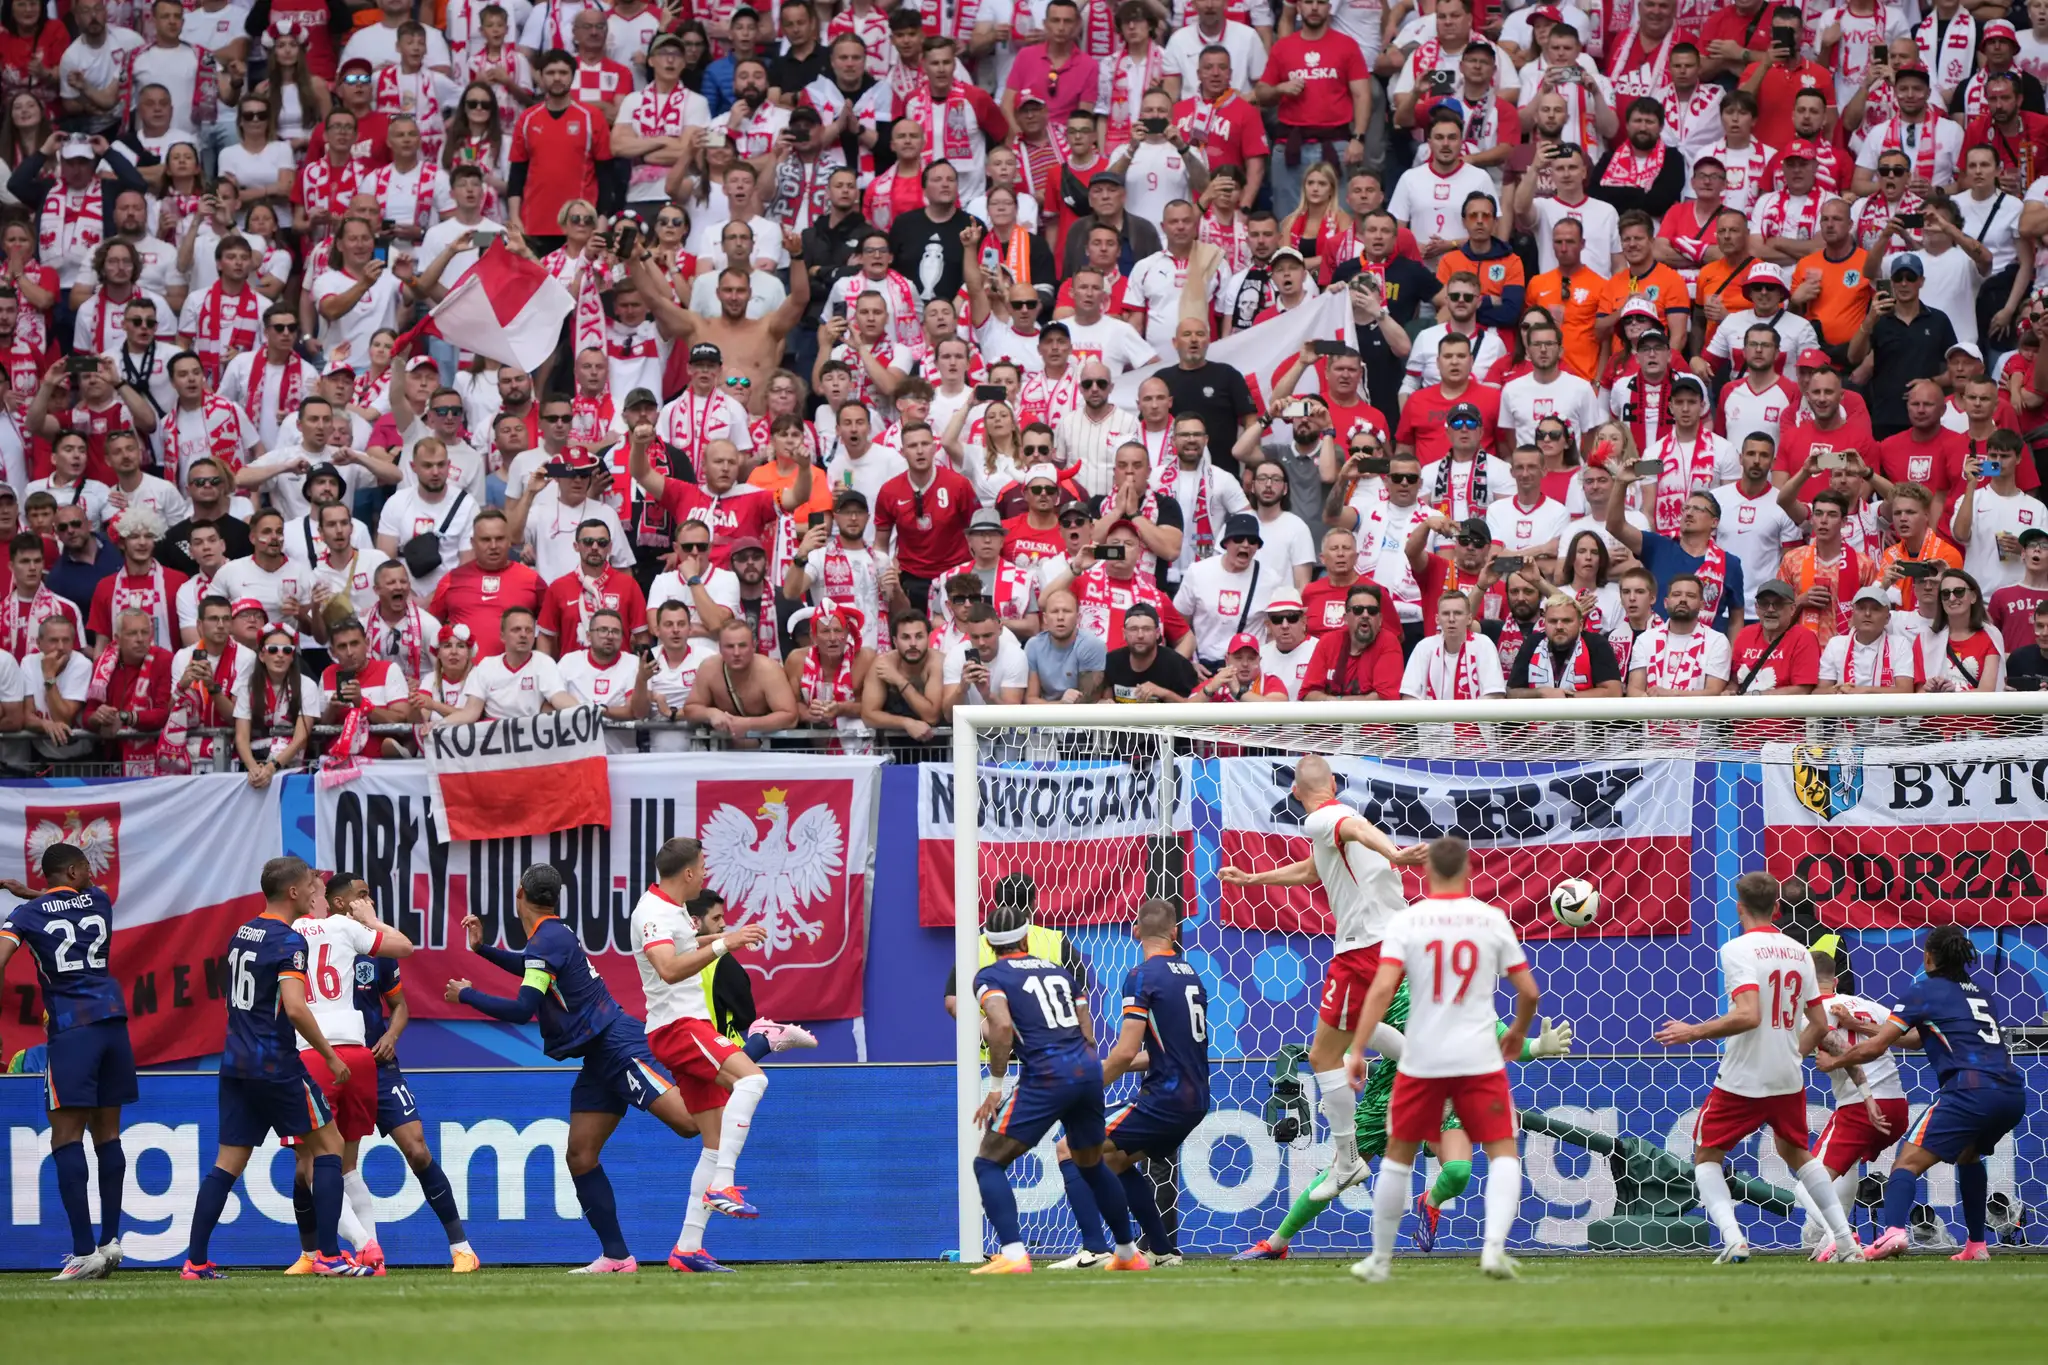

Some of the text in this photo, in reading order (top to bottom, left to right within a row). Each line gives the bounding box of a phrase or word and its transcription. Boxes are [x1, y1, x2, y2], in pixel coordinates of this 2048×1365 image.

[1288, 68, 1334, 80] POLSKA
[1177, 113, 1230, 137] POKA
[1147, 172, 1157, 191] 9
[1436, 214, 1445, 233] 9
[938, 487, 948, 509] 9
[1015, 540, 1057, 554] POLSKA
[2007, 598, 2044, 614] POLS
[1743, 648, 1784, 661] POLKA
[1793, 847, 2048, 902] ODRZA
[42, 893, 93, 913] DUMFRIES
[43, 914, 108, 973] 22
[227, 947, 258, 1012] 16
[1424, 938, 1479, 1006] 19
[1022, 975, 1080, 1029] 10
[1325, 979, 1337, 1003] 2
[1768, 969, 1803, 1031] 13
[1184, 985, 1206, 1042] 6
[1966, 998, 2001, 1045] 5
[626, 1069, 642, 1092] 4
